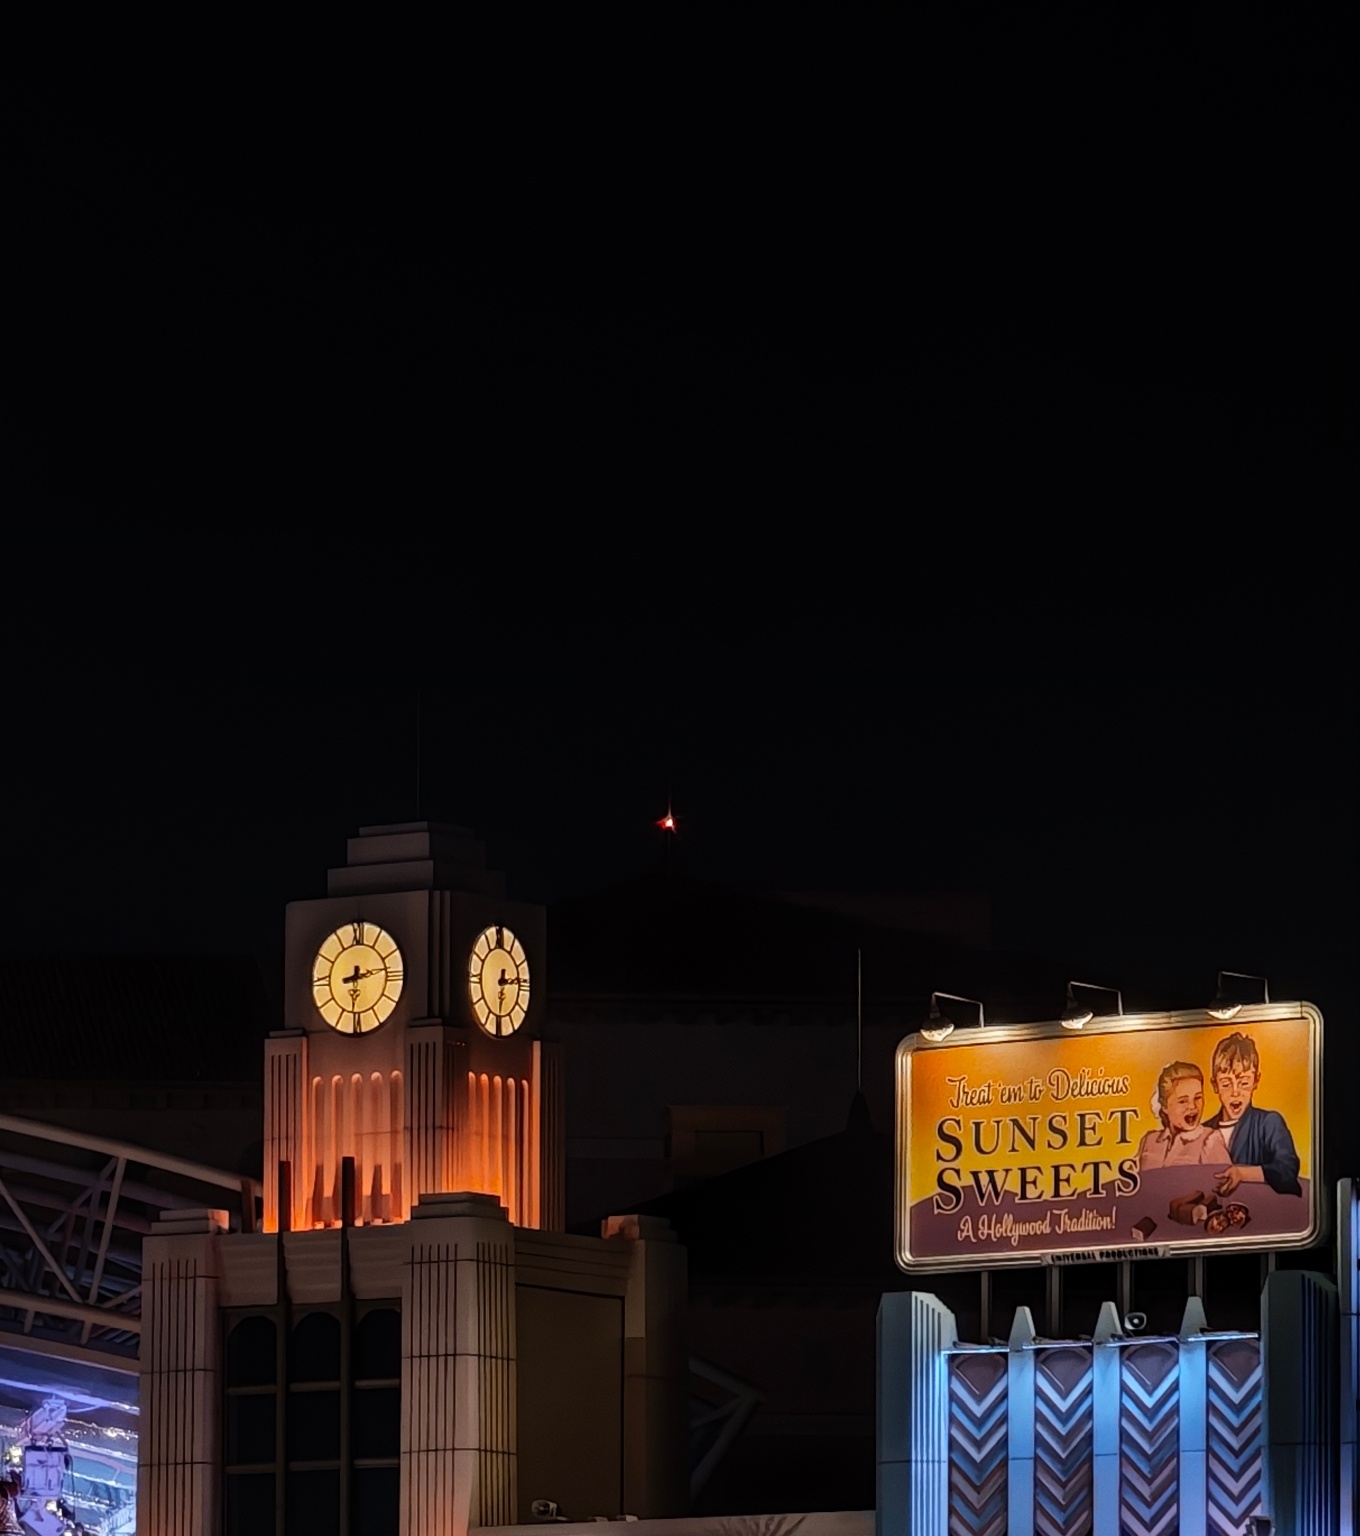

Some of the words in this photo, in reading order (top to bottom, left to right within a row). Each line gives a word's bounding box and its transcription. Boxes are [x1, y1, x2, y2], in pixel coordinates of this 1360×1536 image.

[946, 1075, 993, 1109] Treat
[1026, 1075, 1045, 1103] to
[1047, 1067, 1131, 1103] Delicious
[935, 1108, 1140, 1163] SUNSET
[933, 1157, 1140, 1215] SWEETS
[957, 1215, 977, 1243] A
[978, 1211, 1051, 1247] Hollywood
[1052, 1205, 1117, 1235] Tradition!
